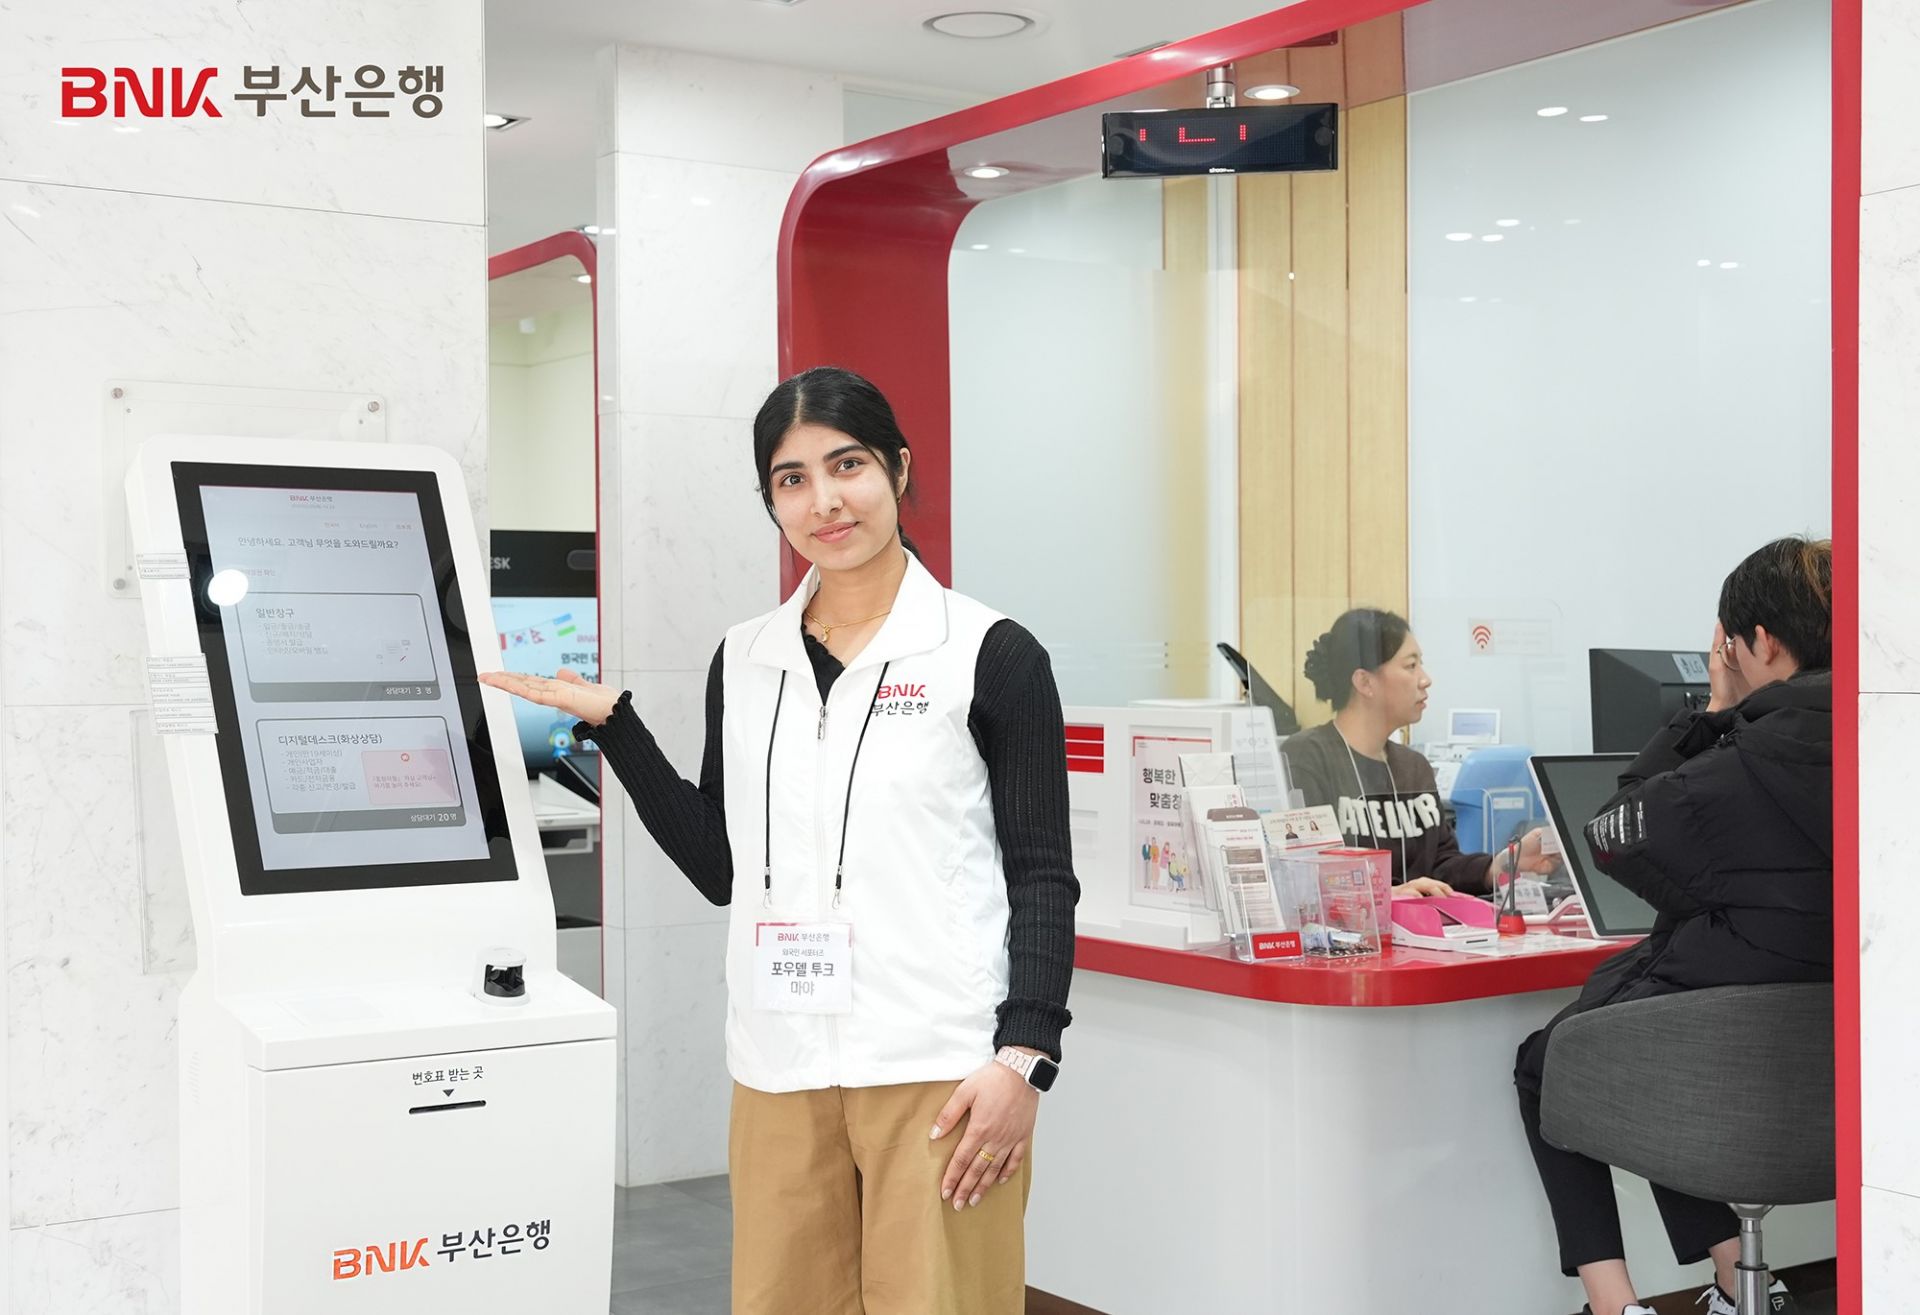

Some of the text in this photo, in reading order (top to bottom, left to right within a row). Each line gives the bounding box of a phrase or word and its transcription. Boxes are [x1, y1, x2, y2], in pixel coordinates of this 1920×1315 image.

[288, 537, 314, 548] 고객님
[316, 538, 341, 548] 무엇을
[344, 539, 399, 550] 도와드릴까요?
[878, 684, 926, 699] BNK
[872, 701, 930, 716] 부산은행
[278, 734, 383, 745] 디지털데스크(화상상담)
[1143, 768, 1176, 785] 행복한
[778, 933, 830, 942] BNK 부산은행
[1275, 940, 1296, 949] 부산은행
[782, 948, 824, 957] 외국인 서포터즈
[771, 962, 835, 977] 포우델 투크
[791, 980, 815, 996] 마야
[412, 1066, 484, 1086] 번호표 받는 곳
[333, 1219, 550, 1280] BNK 부산은행
